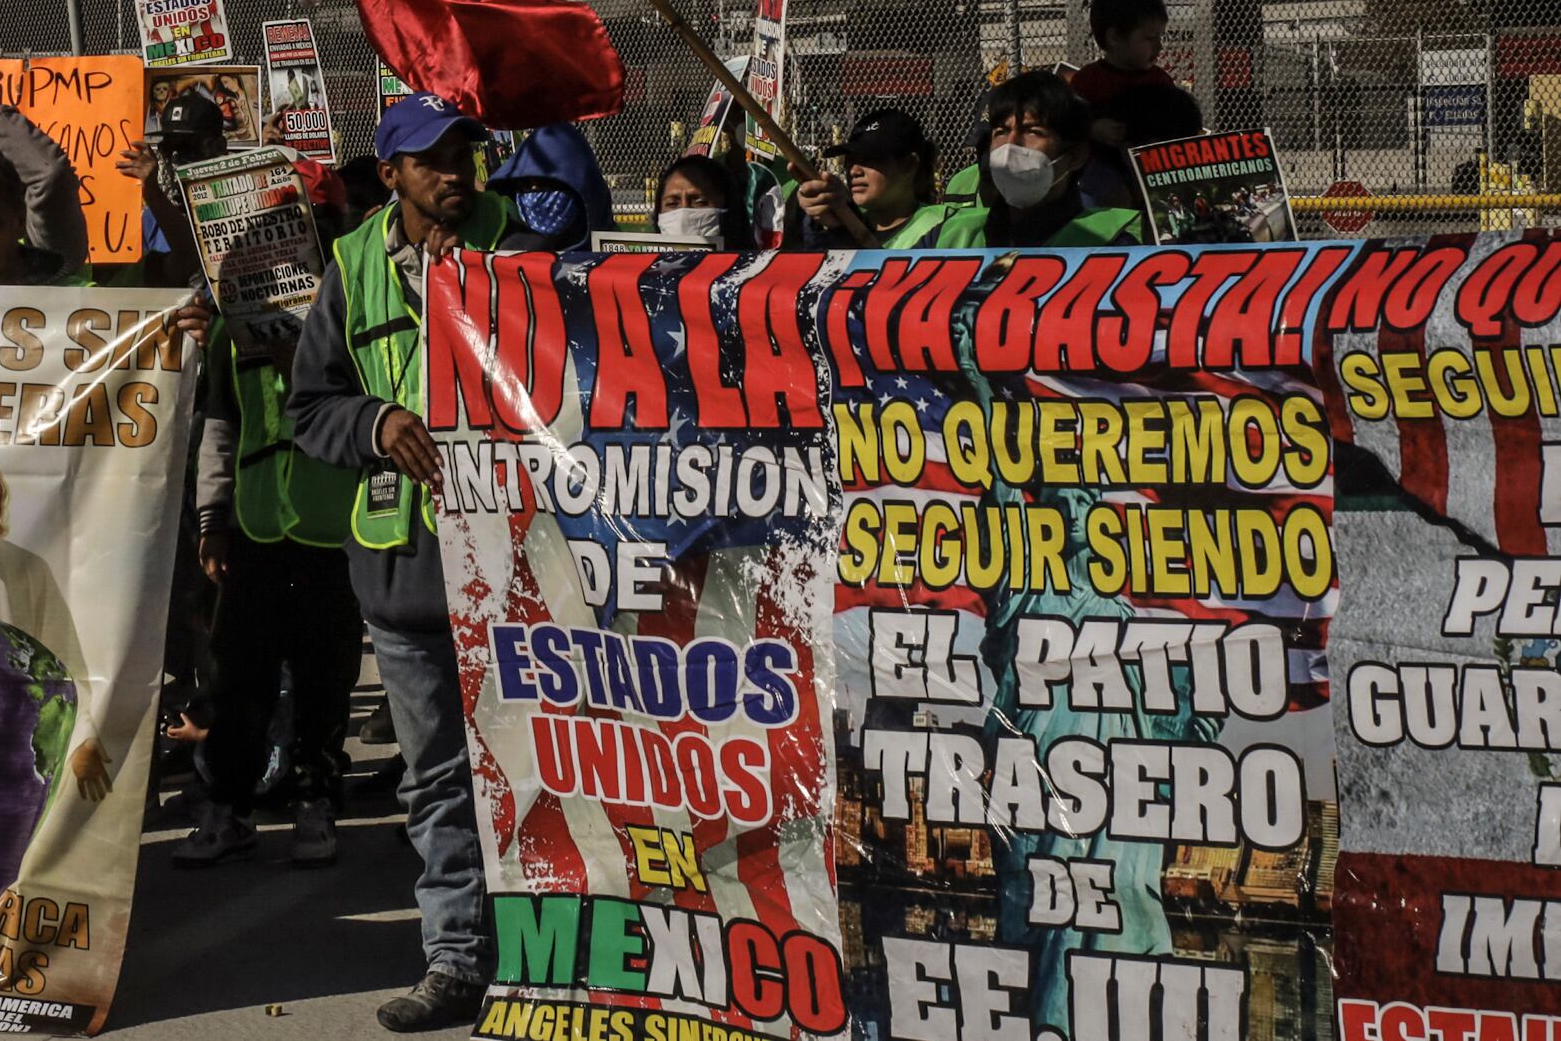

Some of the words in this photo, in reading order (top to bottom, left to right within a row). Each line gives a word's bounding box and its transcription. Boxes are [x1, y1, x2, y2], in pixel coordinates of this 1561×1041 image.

[146, 33, 225, 59] MEXICO
[153, 7, 210, 28] UNIDOS
[174, 26, 191, 38] EN
[296, 41, 312, 49] MEXICO
[188, 49, 227, 61] FRONTERAS
[287, 111, 326, 131] 50,000
[1140, 132, 1269, 175] MIGRANTES
[187, 164, 218, 175] Jueves
[219, 161, 226, 169] 2
[210, 174, 255, 198] TRATADO
[271, 167, 287, 176] 164
[1146, 158, 1273, 187] CENTROAMERICANOS
[200, 222, 228, 239] ROBO
[230, 219, 244, 233] DE
[245, 205, 303, 230] NUESTRO
[204, 221, 307, 254] TERRITORIO
[239, 262, 309, 288] DEPORTACIONES
[241, 276, 315, 302] NOCTURNAS
[1328, 246, 1467, 334] NO
[63, 308, 185, 373] SIN
[428, 252, 568, 432] NO
[587, 252, 672, 432] A
[678, 251, 827, 431] LA
[824, 254, 983, 388] ¡YA
[972, 248, 1343, 375] BASTA!
[834, 399, 927, 486] NO
[941, 394, 1331, 490] QUEREMOS
[436, 441, 829, 518] INTROMISION
[568, 538, 668, 611] DE
[838, 498, 1072, 595] SEGUIR
[1085, 502, 1335, 600] SIENDO
[489, 624, 800, 725] ESTADOS
[869, 607, 983, 704] EL
[1015, 615, 1290, 721] PATIO
[528, 713, 771, 825] UNIDOS
[861, 726, 1307, 852] TRASERO
[627, 823, 707, 893] EN
[1028, 855, 1123, 933] DE
[491, 893, 849, 1035] MEXICO
